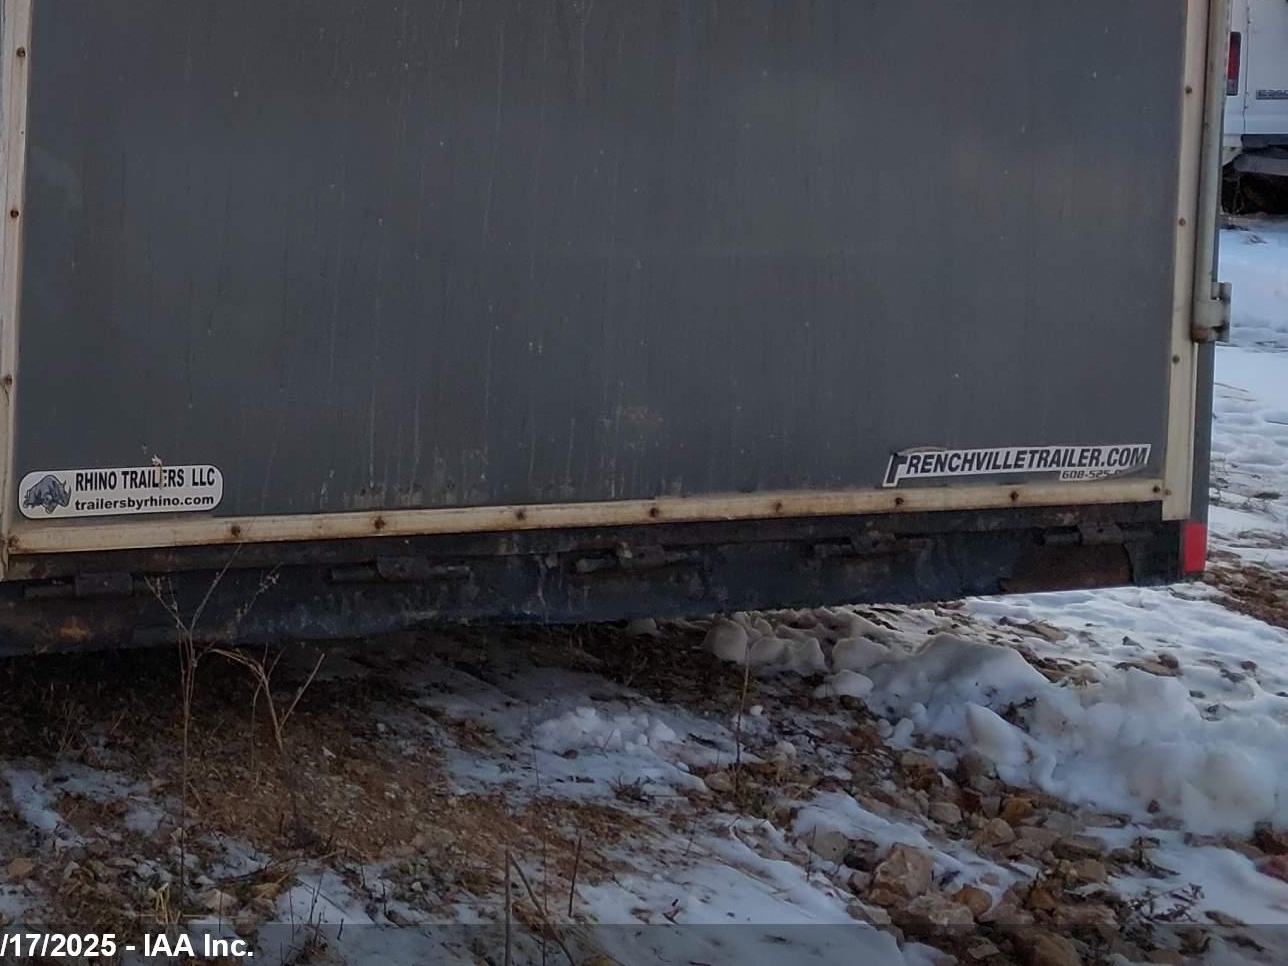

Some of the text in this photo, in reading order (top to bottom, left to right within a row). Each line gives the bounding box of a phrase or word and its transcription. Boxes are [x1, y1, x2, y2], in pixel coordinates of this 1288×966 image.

[886, 447, 1149, 484] FRENCHVILLETRAILER.COM
[75, 471, 117, 492] RHINO
[192, 467, 215, 487] LLC
[75, 494, 214, 511] trailersbyrhino.com
